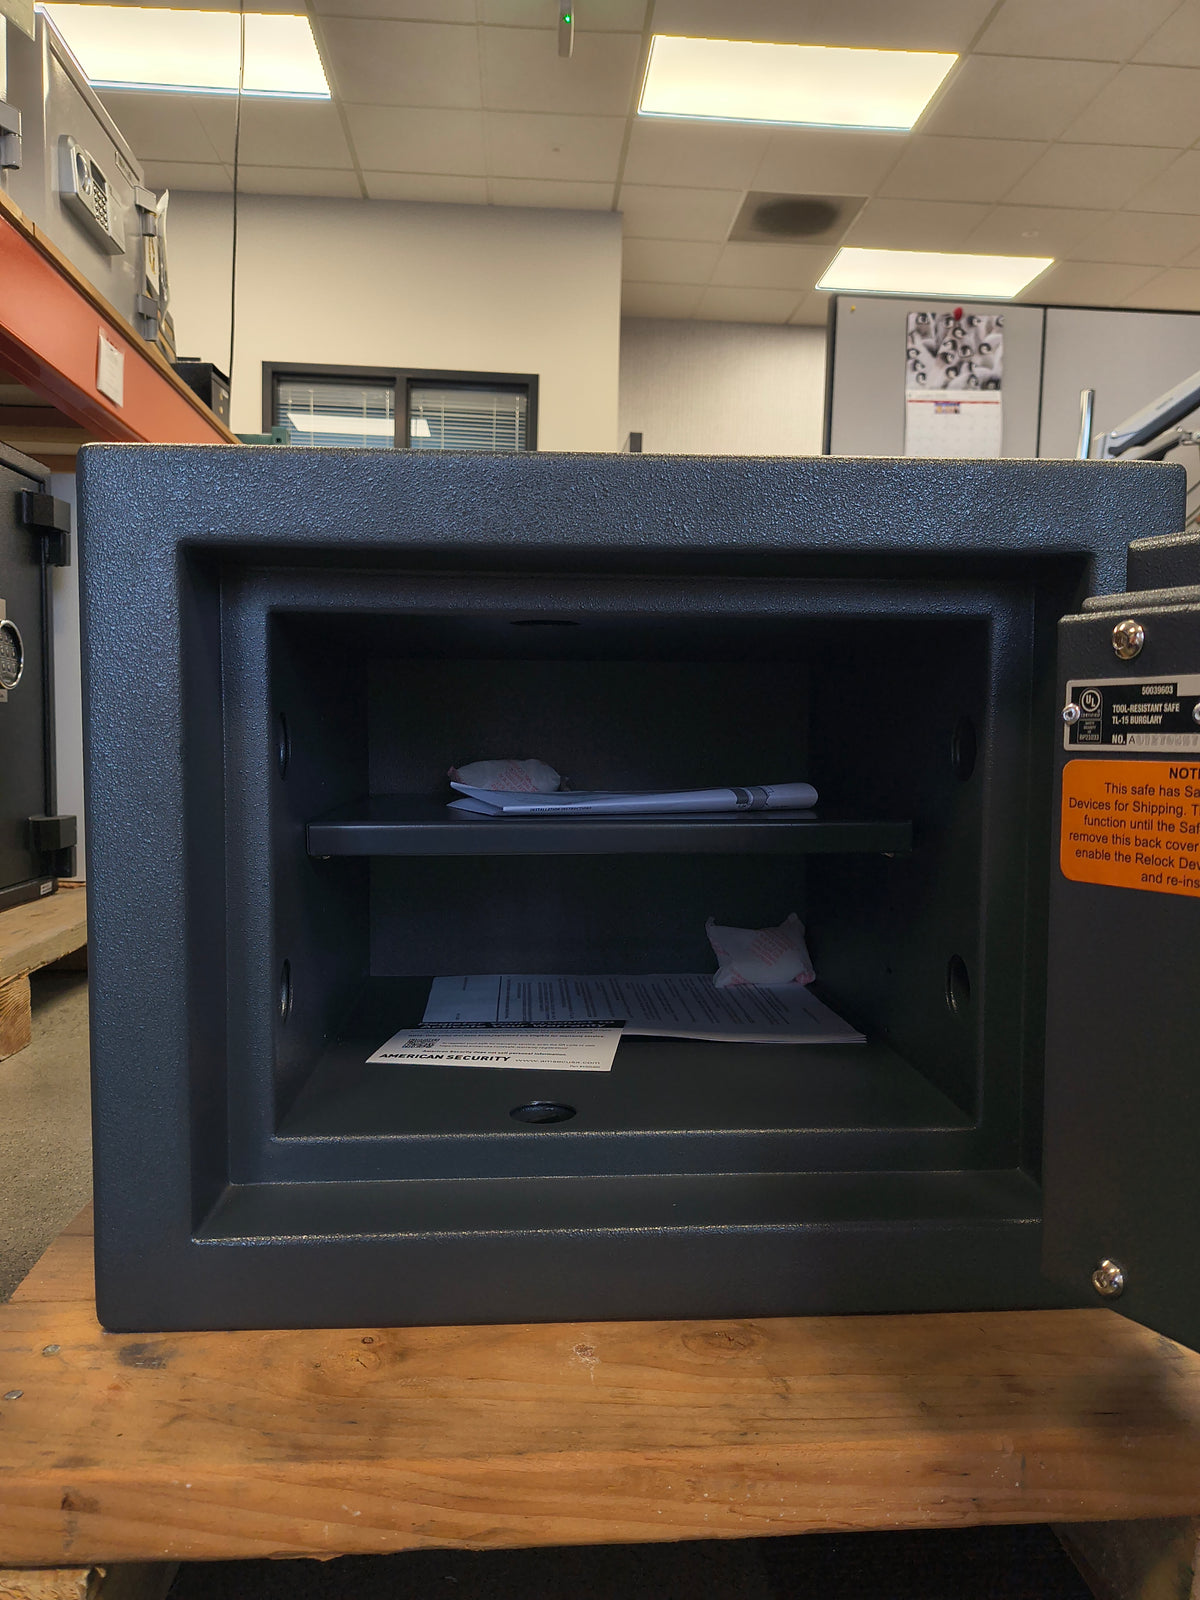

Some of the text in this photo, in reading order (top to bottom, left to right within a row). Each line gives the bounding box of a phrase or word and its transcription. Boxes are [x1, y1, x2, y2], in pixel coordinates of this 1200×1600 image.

[1112, 703, 1180, 714] TOOL-RESISTANT SAFE
[1112, 715, 1162, 725] TL-15 BURGLARY
[1111, 734, 1126, 744] NO.
[1104, 782, 1200, 798] This safe has Sa
[1069, 798, 1200, 818] Devices for Shipping. T
[1084, 815, 1200, 834] function until the Saf
[1069, 832, 1199, 852] remove this back cover
[1075, 848, 1110, 861] enable
[1114, 851, 1132, 862] the
[1135, 852, 1174, 868] Relock
[1141, 872, 1200, 888] and re-ins
